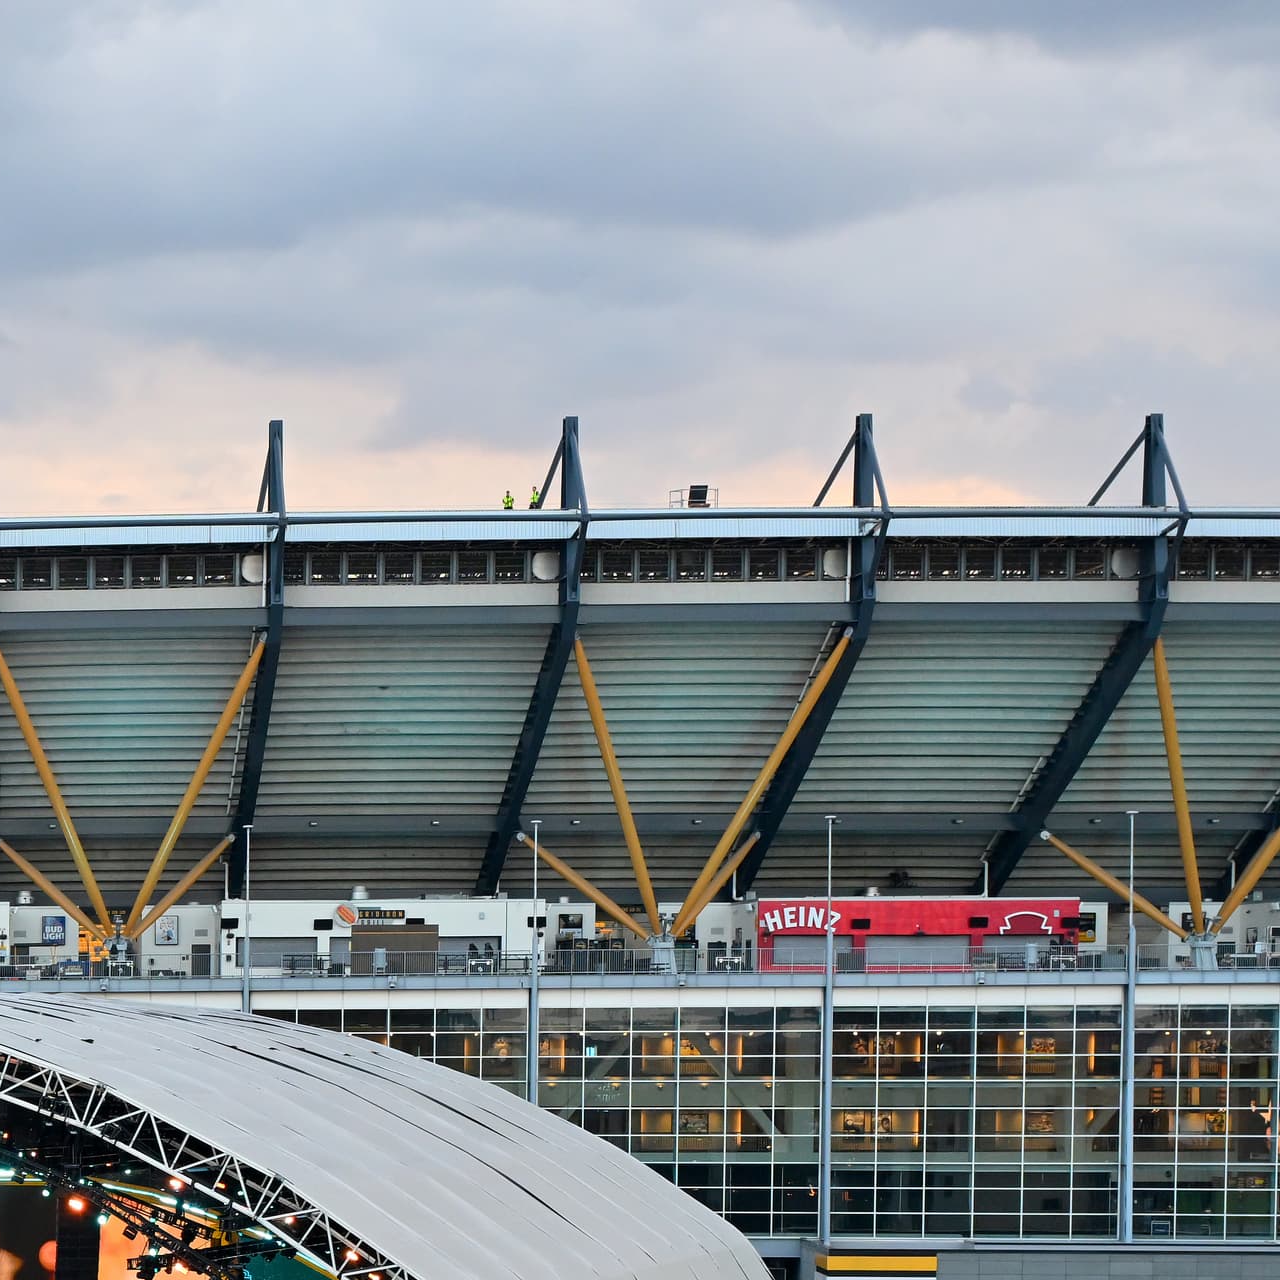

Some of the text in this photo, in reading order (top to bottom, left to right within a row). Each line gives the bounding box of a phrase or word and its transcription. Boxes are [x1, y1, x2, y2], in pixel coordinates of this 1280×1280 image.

[764, 906, 841, 933] HEINZ
[45, 925, 63, 933] BUD
[42, 932, 64, 940] LIGHT
